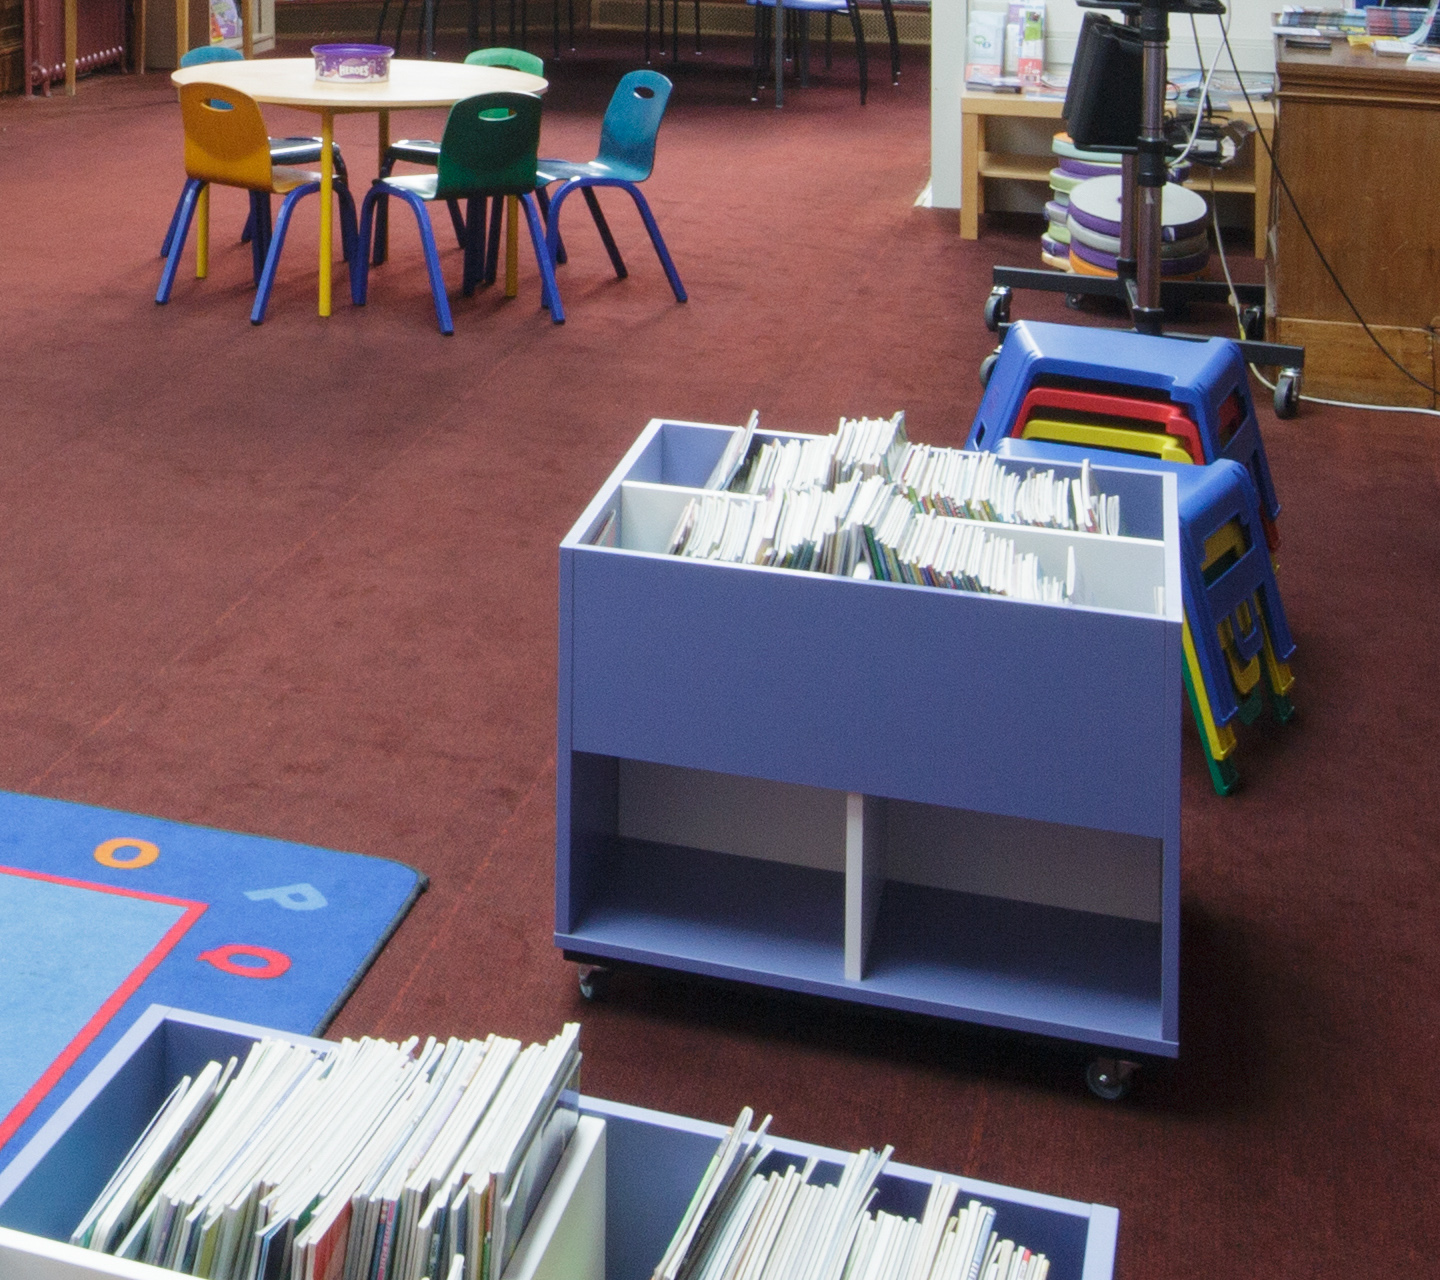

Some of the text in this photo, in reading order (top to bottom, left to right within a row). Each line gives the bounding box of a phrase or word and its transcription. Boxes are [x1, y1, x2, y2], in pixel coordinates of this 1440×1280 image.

[339, 64, 370, 78] HEROES
[93, 837, 161, 870] O
[244, 882, 329, 914] P
[195, 942, 294, 981] Q
